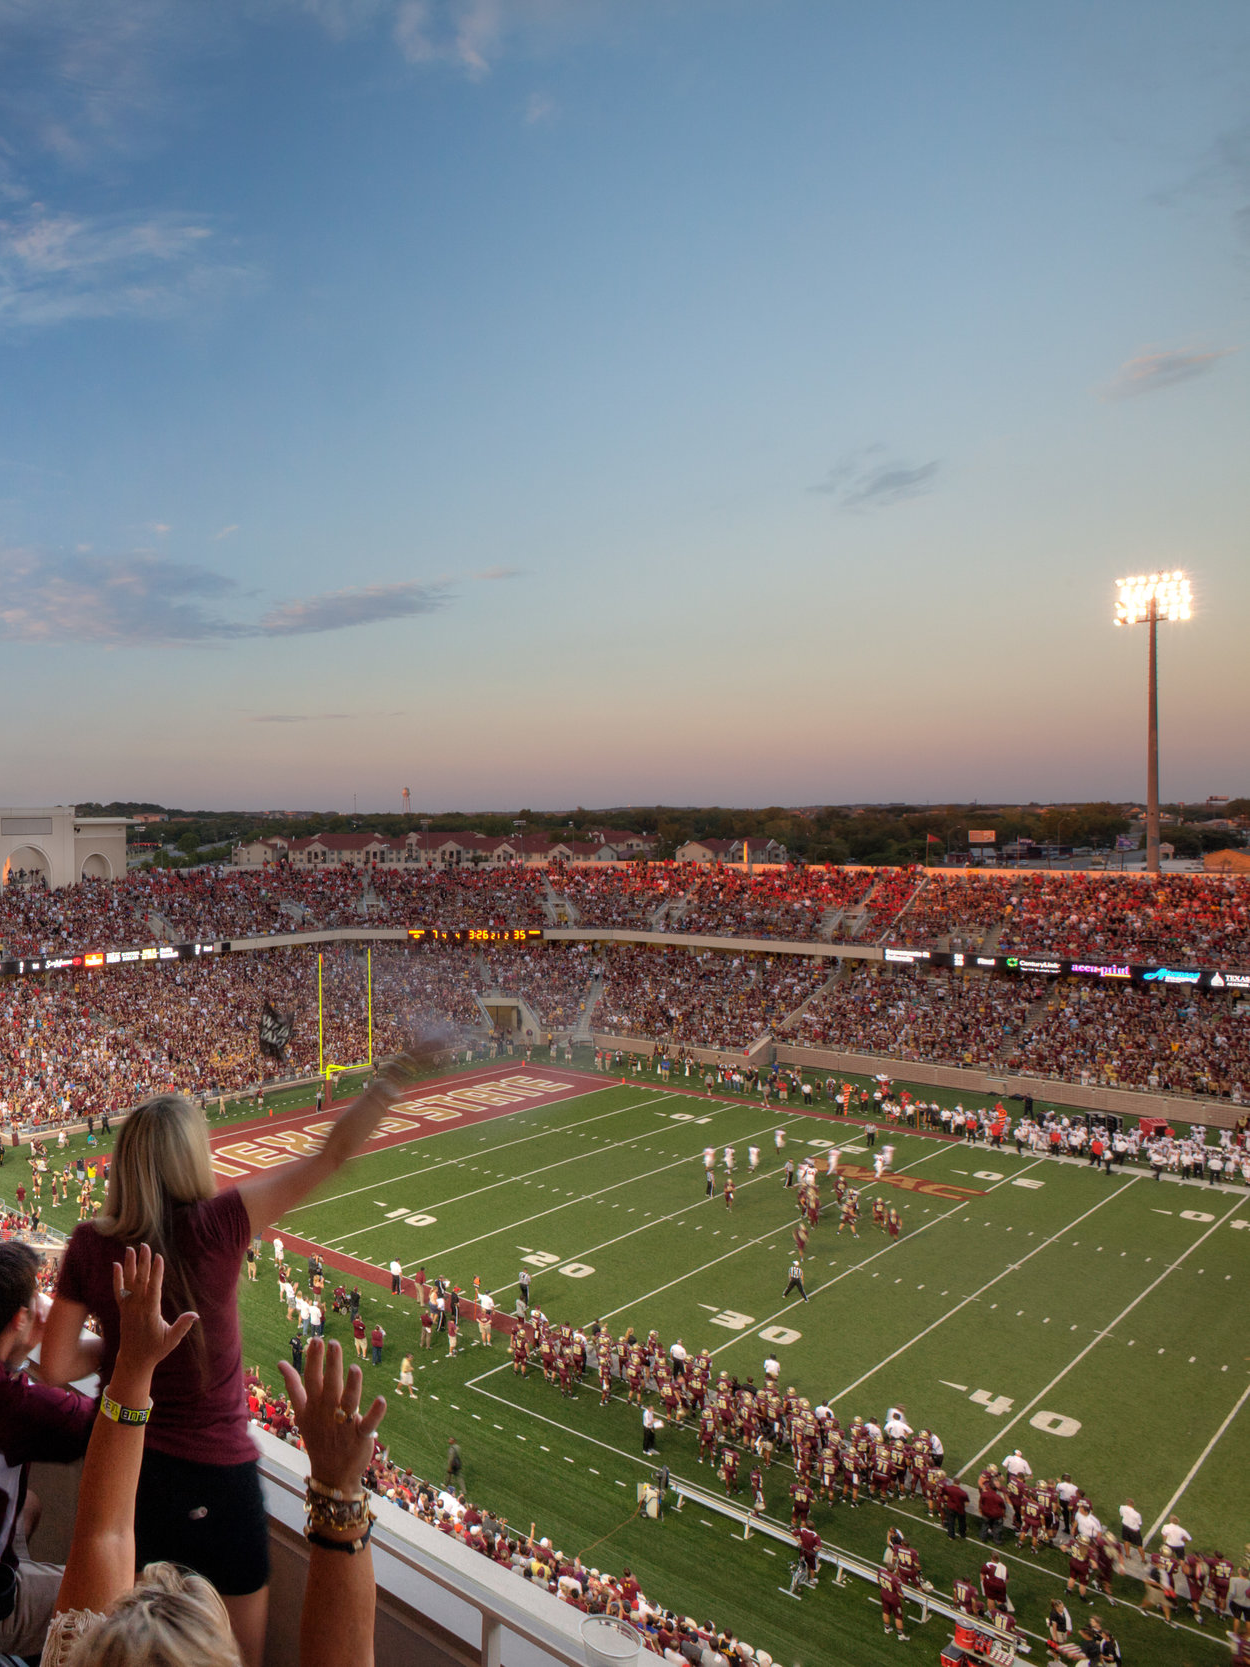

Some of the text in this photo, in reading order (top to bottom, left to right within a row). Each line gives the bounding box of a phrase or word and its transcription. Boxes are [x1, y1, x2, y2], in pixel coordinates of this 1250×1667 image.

[469, 930, 489, 940] 3:26
[513, 930, 526, 940] 35
[1019, 960, 1061, 970] CenturyLink
[388, 1075, 575, 1122] STATE
[383, 1206, 437, 1228] 10
[519, 1251, 597, 1279] 20
[708, 1310, 803, 1346] 30
[968, 1388, 1082, 1437] 40
